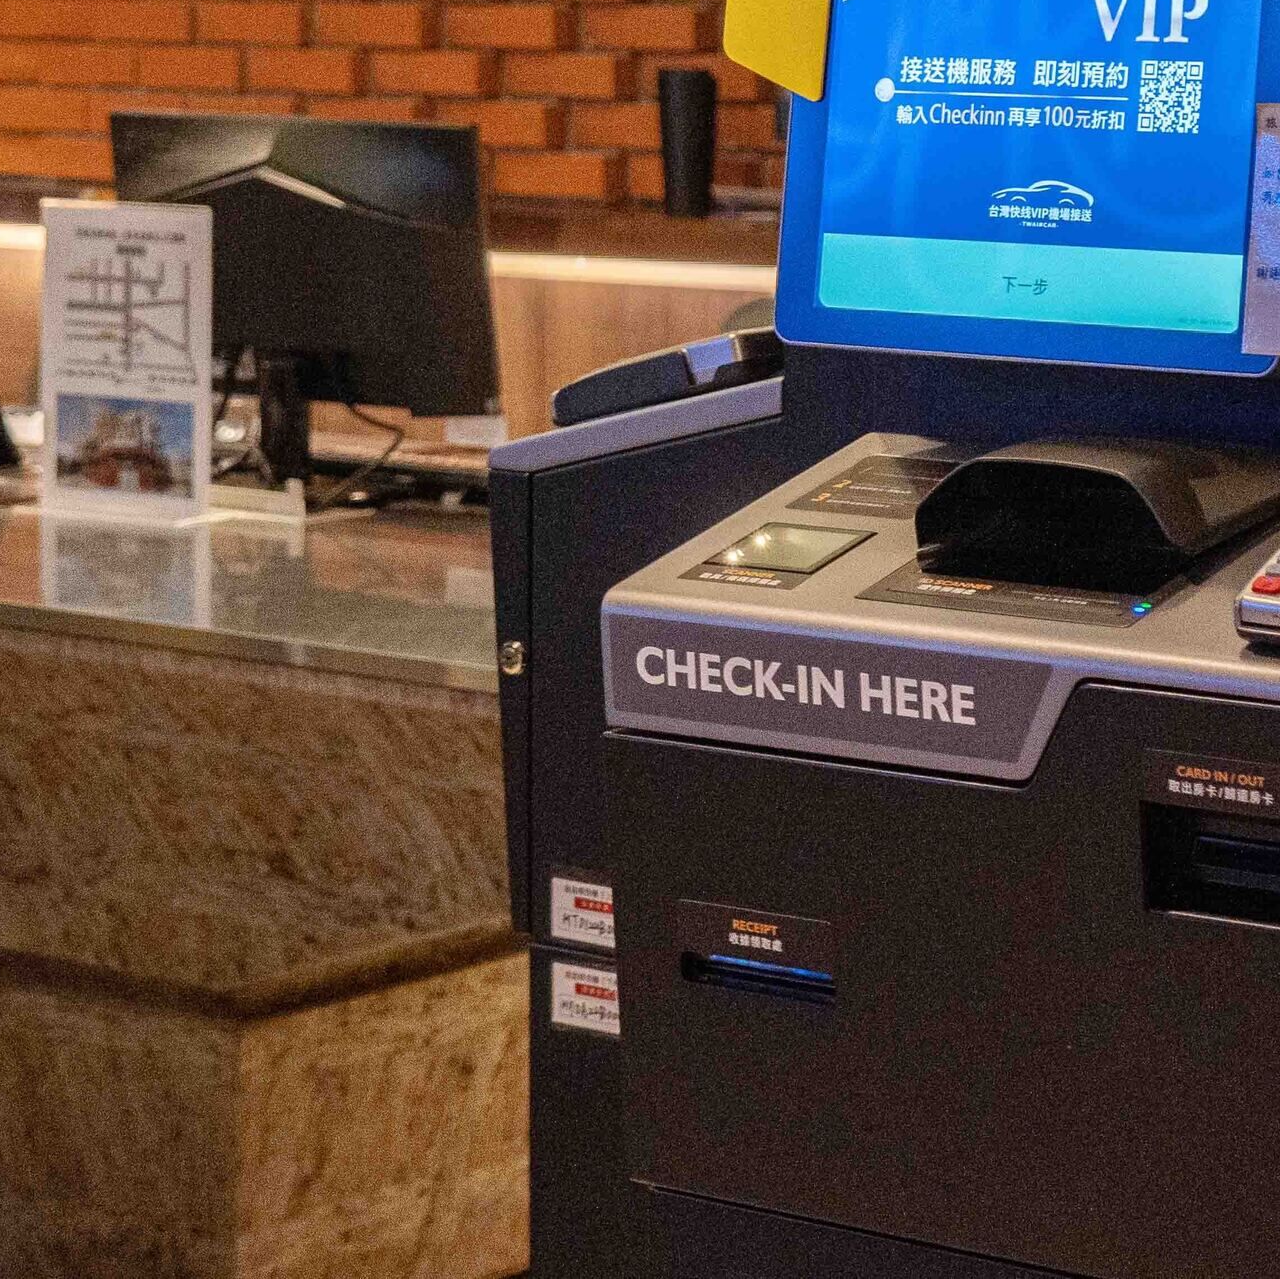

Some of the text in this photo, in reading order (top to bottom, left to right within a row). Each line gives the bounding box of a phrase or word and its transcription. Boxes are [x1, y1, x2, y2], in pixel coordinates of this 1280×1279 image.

[900, 56, 1129, 89] 接送機服務 即刻預約
[1002, 275, 1049, 295] 下一步
[636, 646, 977, 726] CHECK-IN HERE
[1175, 765, 1211, 780] CARD
[1215, 770, 1229, 783] IN
[1237, 774, 1266, 788] OUT
[732, 918, 779, 935] RECEIPT
